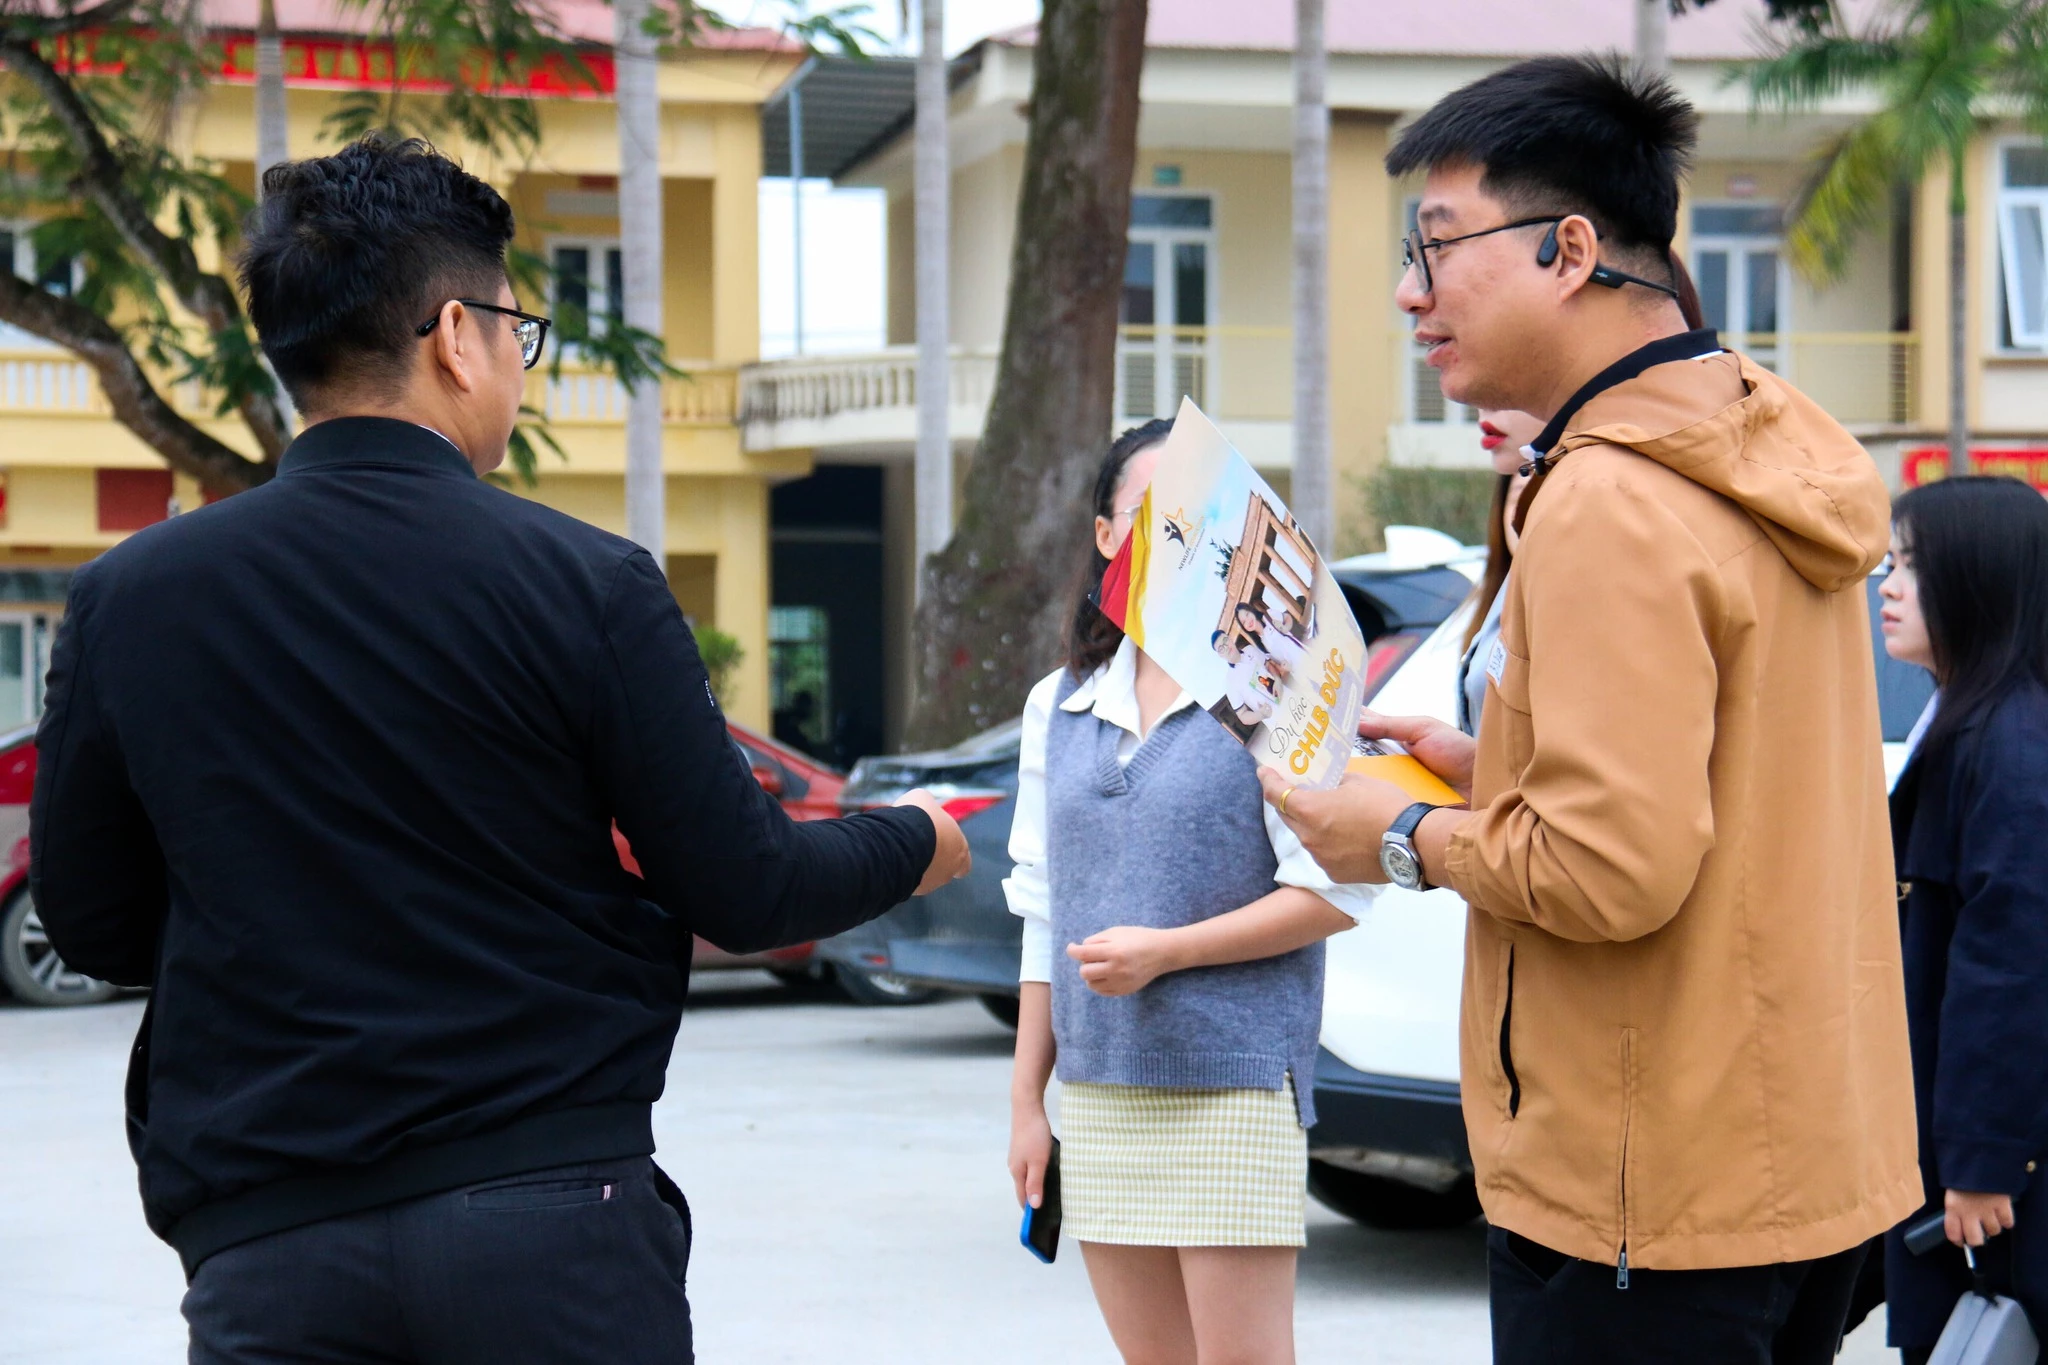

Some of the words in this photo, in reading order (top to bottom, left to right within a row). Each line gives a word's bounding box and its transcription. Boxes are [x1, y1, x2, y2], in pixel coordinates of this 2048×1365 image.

[1178, 547, 1191, 570] NEWLIFE
[1290, 696, 1307, 724] học
[1289, 705, 1329, 775] CHLB
